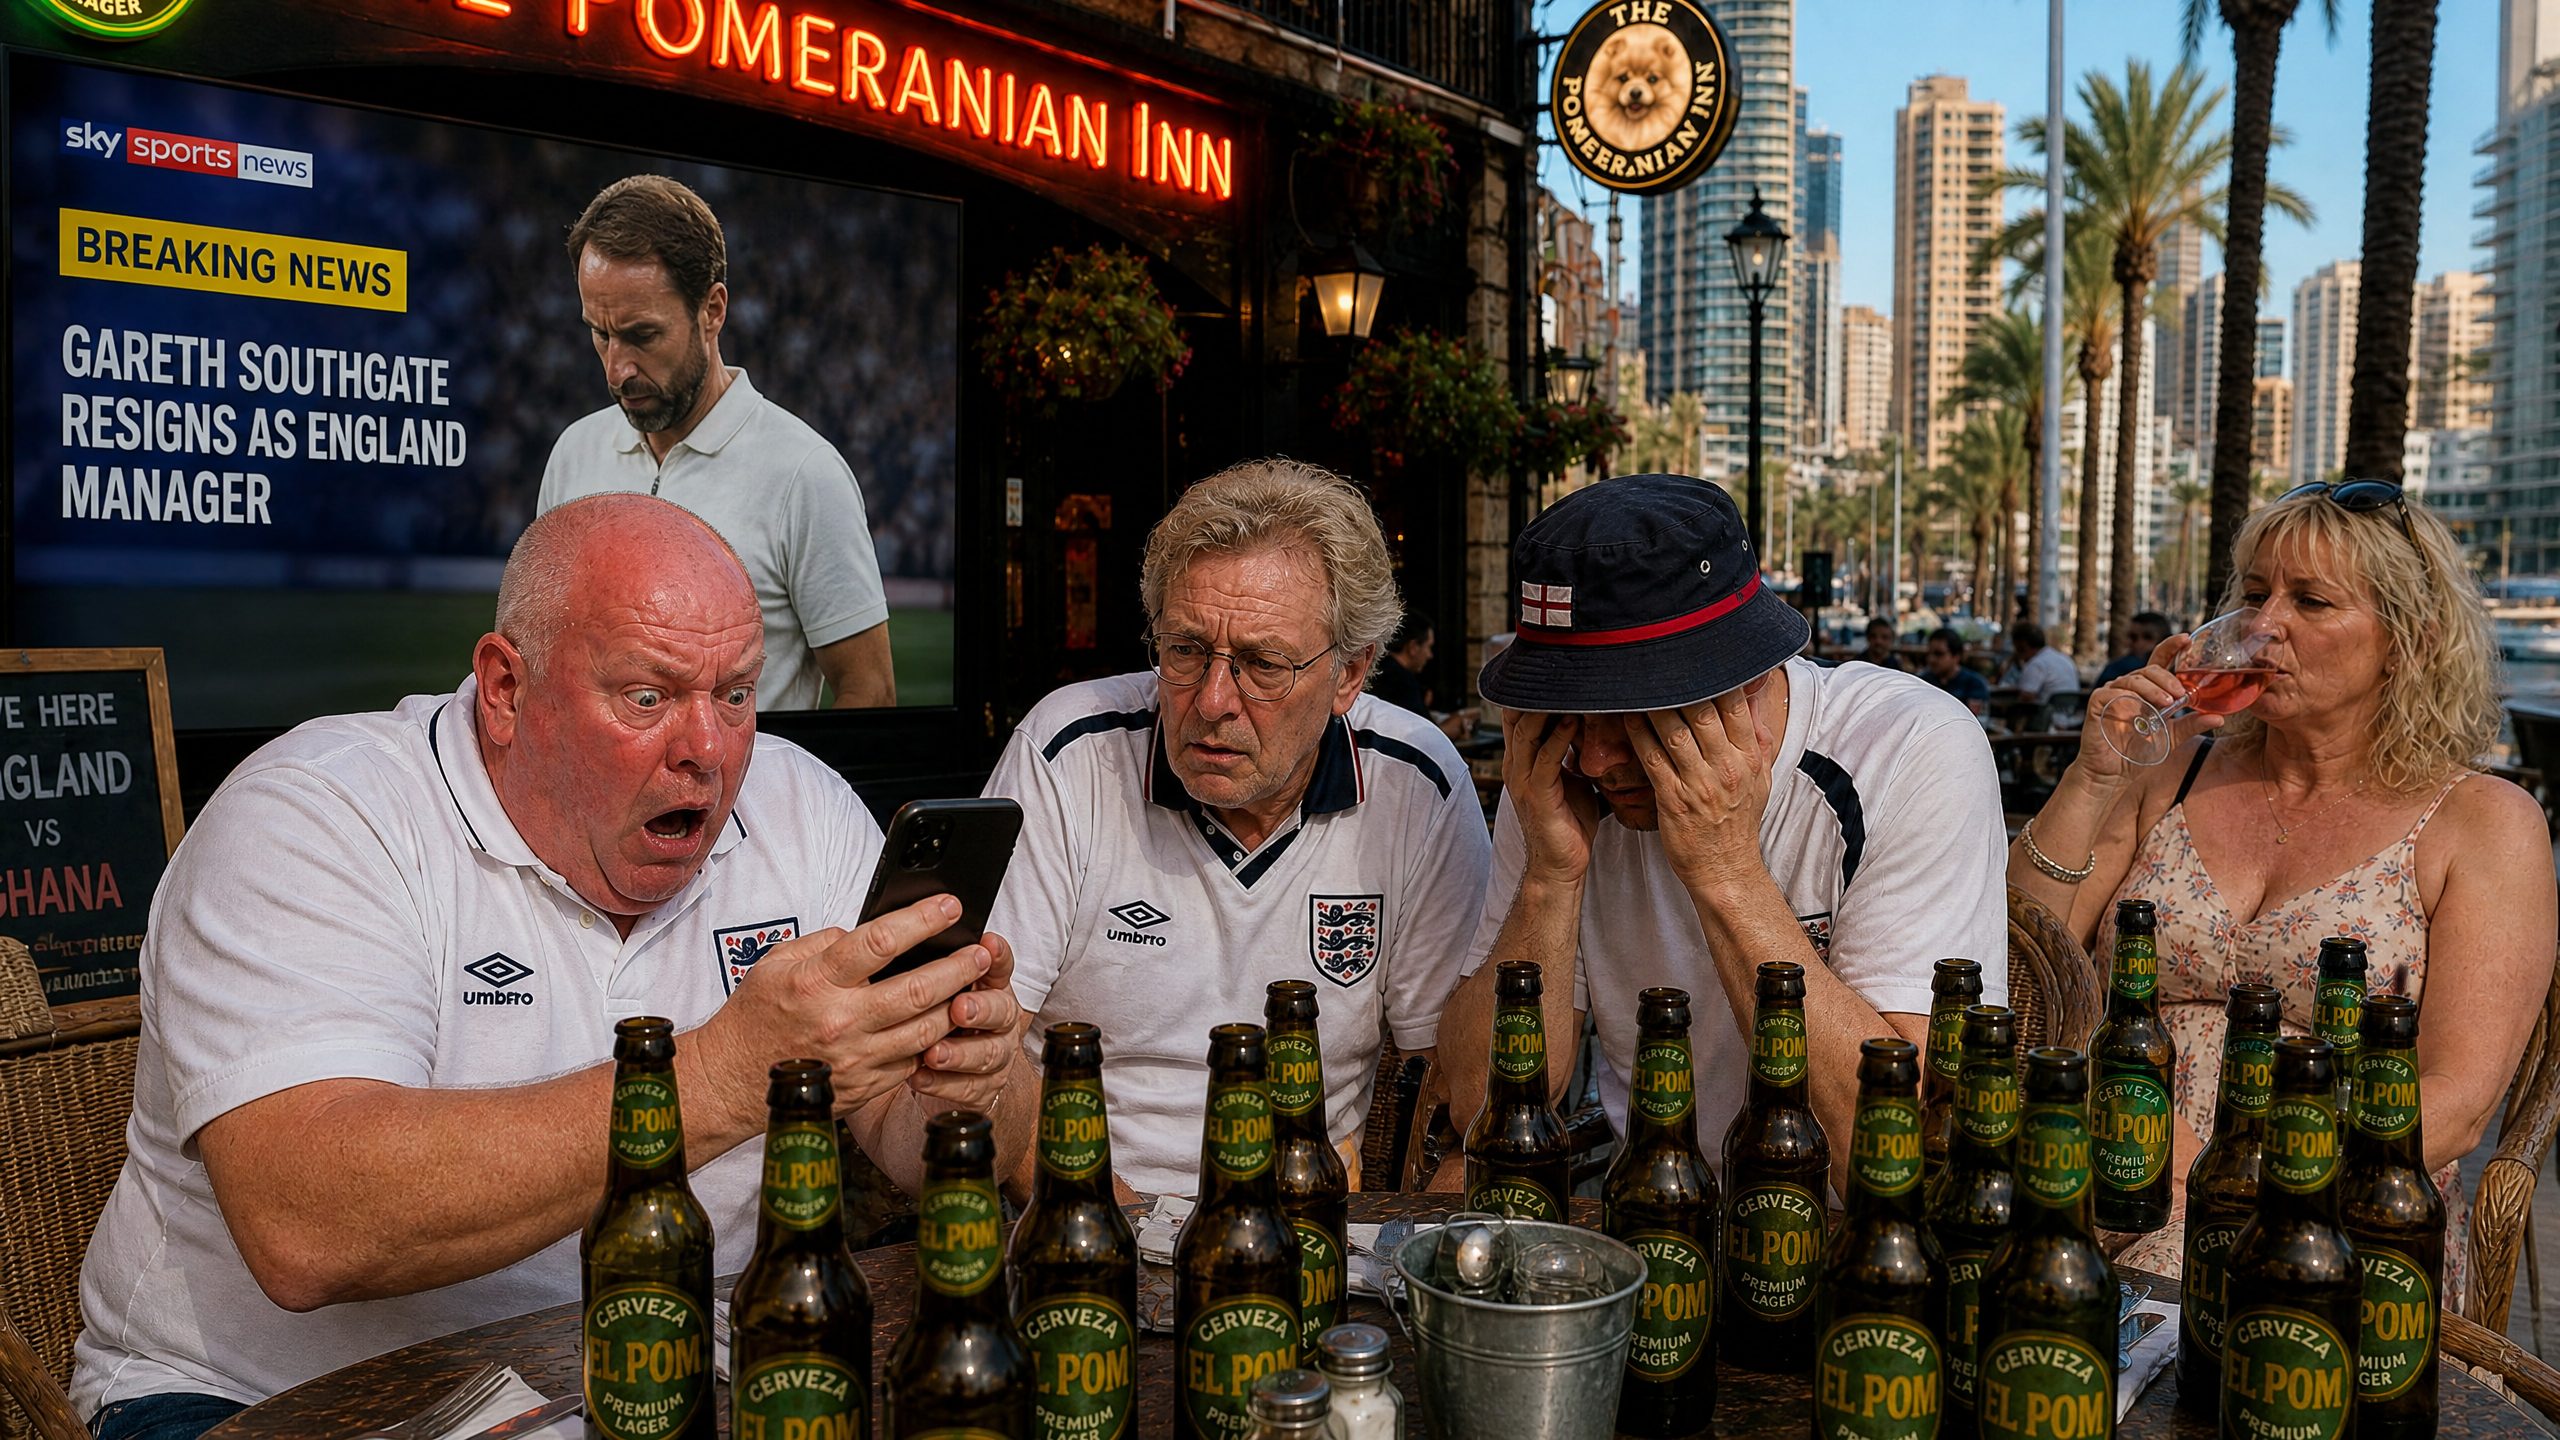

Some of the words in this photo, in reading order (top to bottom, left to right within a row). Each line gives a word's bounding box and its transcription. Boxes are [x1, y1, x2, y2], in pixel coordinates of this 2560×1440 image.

[1609, 1, 1673, 27] THE
[1690, 61, 1716, 119] INN
[66, 121, 122, 158] sky
[133, 135, 232, 169] sports
[244, 153, 307, 179] news
[1131, 101, 1234, 200] INN
[77, 226, 276, 284] BREAKING
[290, 252, 391, 297] NEWS
[62, 323, 226, 389] GARETH
[239, 340, 450, 406] SOUTHGATE
[61, 394, 237, 456] RESIGNS
[247, 407, 297, 460] AS
[307, 411, 467, 468] ENGLAND
[61, 463, 272, 525] MANAGER
[0, 696, 25, 729] E
[38, 692, 118, 727] HERE
[0, 751, 132, 800] GLAND
[24, 818, 61, 847] VS
[2128, 957, 2157, 975] POM
[1496, 1014, 1537, 1029] CERVEZA
[2314, 1003, 2329, 1025] EL
[1508, 1032, 1543, 1054] POM
[1640, 1048, 1685, 1065] CERVEZA
[1753, 1034, 1769, 1057] EL
[1771, 1035, 1806, 1058] POM
[1282, 1060, 1319, 1085] POM
[1633, 1065, 1650, 1091] EL
[1652, 1069, 1691, 1093] POM
[2223, 1058, 2239, 1084] EL
[2241, 1063, 2272, 1087] PO
[2359, 1058, 2409, 1078] CERVEZA
[1046, 1092, 1098, 1111] CERVEZA
[1214, 1092, 1264, 1111] CERVEZA
[1977, 1089, 2017, 1114] POM
[2098, 1084, 2160, 1107] CERVEZA
[2353, 1077, 2370, 1104] EL
[2372, 1082, 2416, 1107] POM
[612, 1106, 629, 1132] EL
[631, 1105, 677, 1133] POM
[1041, 1115, 1060, 1142] EL
[1063, 1114, 1105, 1143] POM
[1208, 1116, 1228, 1143] EL
[1232, 1114, 1272, 1144] POM
[2089, 1107, 2113, 1140] EL
[2116, 1113, 2167, 1145] POM
[2271, 1105, 2326, 1126] CERVEZA
[1855, 1128, 1873, 1157] EL
[1876, 1132, 1920, 1160] POM
[2044, 1141, 2089, 1170] POM
[2264, 1124, 2282, 1154] EL
[2286, 1130, 2334, 1158] POM
[2099, 1147, 2155, 1167] PREMIUM
[2107, 1165, 2145, 1179] LAGER
[766, 1158, 788, 1189] EL
[790, 1157, 838, 1190] POM
[1473, 1188, 1546, 1216] CERVEZA
[1737, 1193, 1813, 1222] CERVEZA
[920, 1218, 944, 1252] EL
[946, 1217, 998, 1252] POM
[1728, 1223, 1756, 1263] EL
[1762, 1227, 1820, 1266] POM
[1636, 1242, 1697, 1274] RVEZA
[1741, 1272, 1807, 1293] PREMIUM
[2360, 1257, 2416, 1293] VEZA
[596, 1297, 688, 1329] CERVEZA
[1642, 1279, 1707, 1321] POM
[1752, 1291, 1796, 1307] LAGER
[1026, 1307, 1118, 1339] CERVEZA
[1199, 1309, 1288, 1342] CERVEZA
[1630, 1331, 1691, 1351] REMIUM
[1832, 1328, 1927, 1365] CERVEZA
[2237, 1320, 2331, 1360] CERVEZA
[589, 1334, 620, 1382] EL
[625, 1333, 701, 1384] POM
[1056, 1344, 1129, 1396] POM
[1188, 1347, 1224, 1396] EL
[1631, 1347, 1680, 1367] LAGER
[1995, 1346, 2095, 1385] CERVEZA
[2359, 1352, 2406, 1369] MIUM
[748, 1368, 849, 1402] CERVEZA
[1821, 1362, 1856, 1414] EL
[1862, 1370, 1937, 1420] POM
[2227, 1348, 2256, 1400] EL
[2263, 1362, 2342, 1410] POM
[2359, 1371, 2393, 1387] GER
[603, 1391, 684, 1418] PREMIUM
[1035, 1404, 1114, 1431] PREMIUM
[1984, 1377, 2018, 1432] EL
[2025, 1391, 2104, 1440] POM
[614, 1415, 670, 1435] LAGER
[2240, 1407, 2322, 1440] PREMIUM
